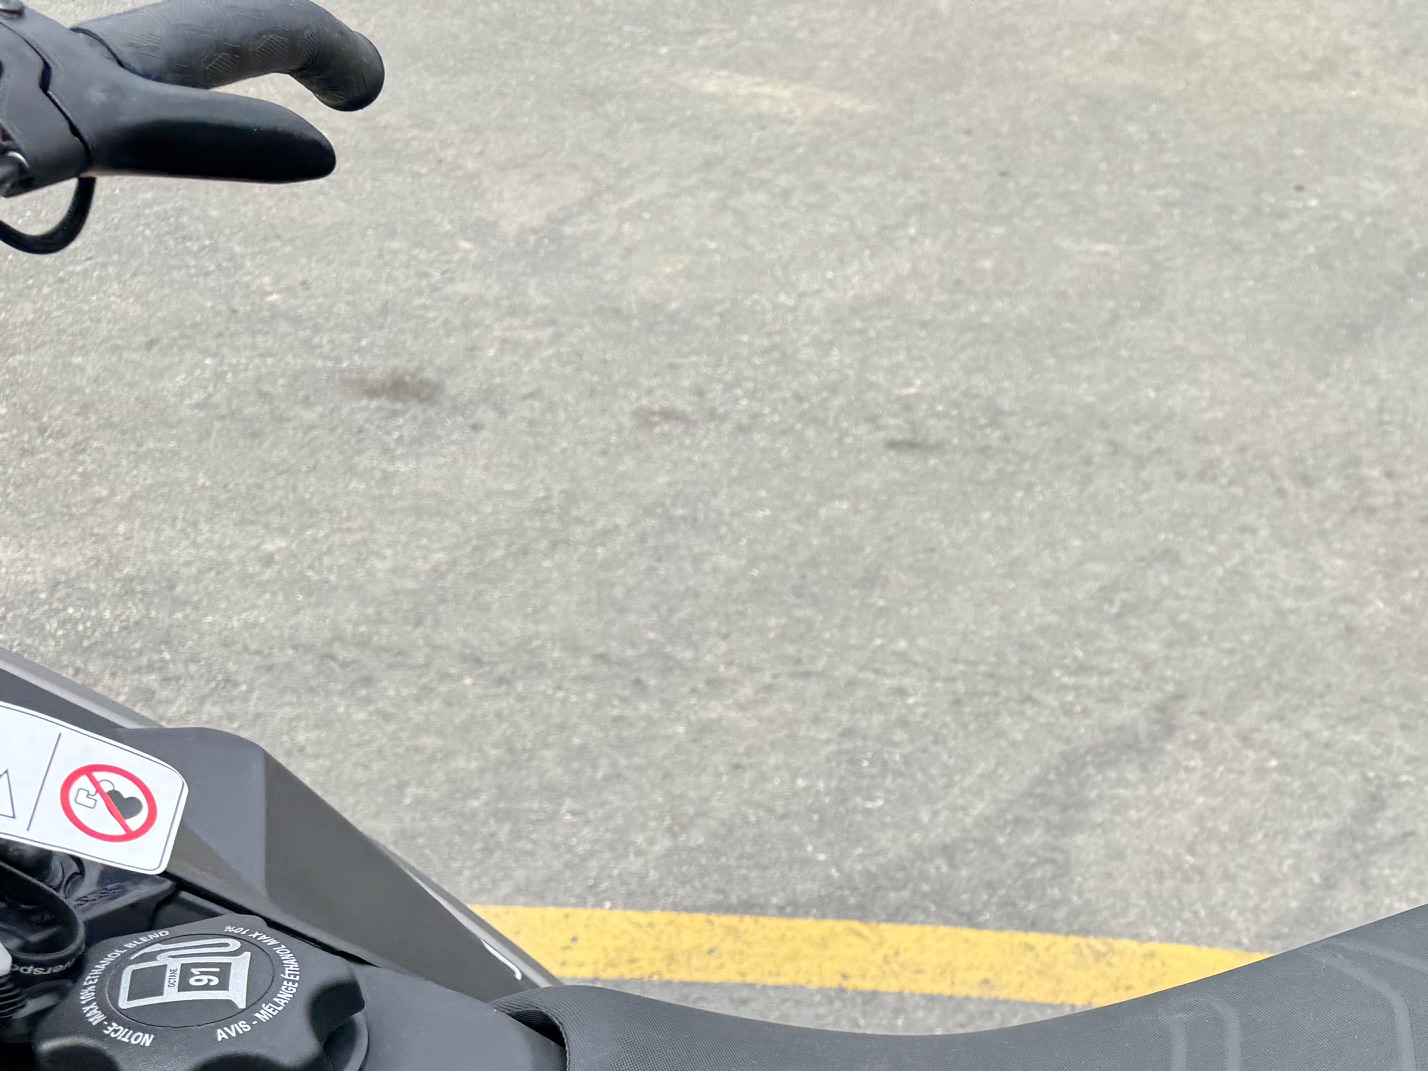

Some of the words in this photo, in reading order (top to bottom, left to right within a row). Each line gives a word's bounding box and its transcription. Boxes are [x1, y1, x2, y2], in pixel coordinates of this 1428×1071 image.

[124, 930, 170, 949] BLEND
[224, 925, 250, 935] 10%
[248, 931, 280, 946] MAX
[83, 949, 128, 986] ETHANOL
[273, 944, 300, 980] ÉTHANOL
[189, 967, 220, 986] 91
[80, 985, 96, 1004] 10%
[254, 980, 299, 1022] MÉLANGE
[82, 1002, 107, 1026] MAX
[103, 1022, 155, 1047] NOTICE
[216, 1020, 251, 1041] AVIS
